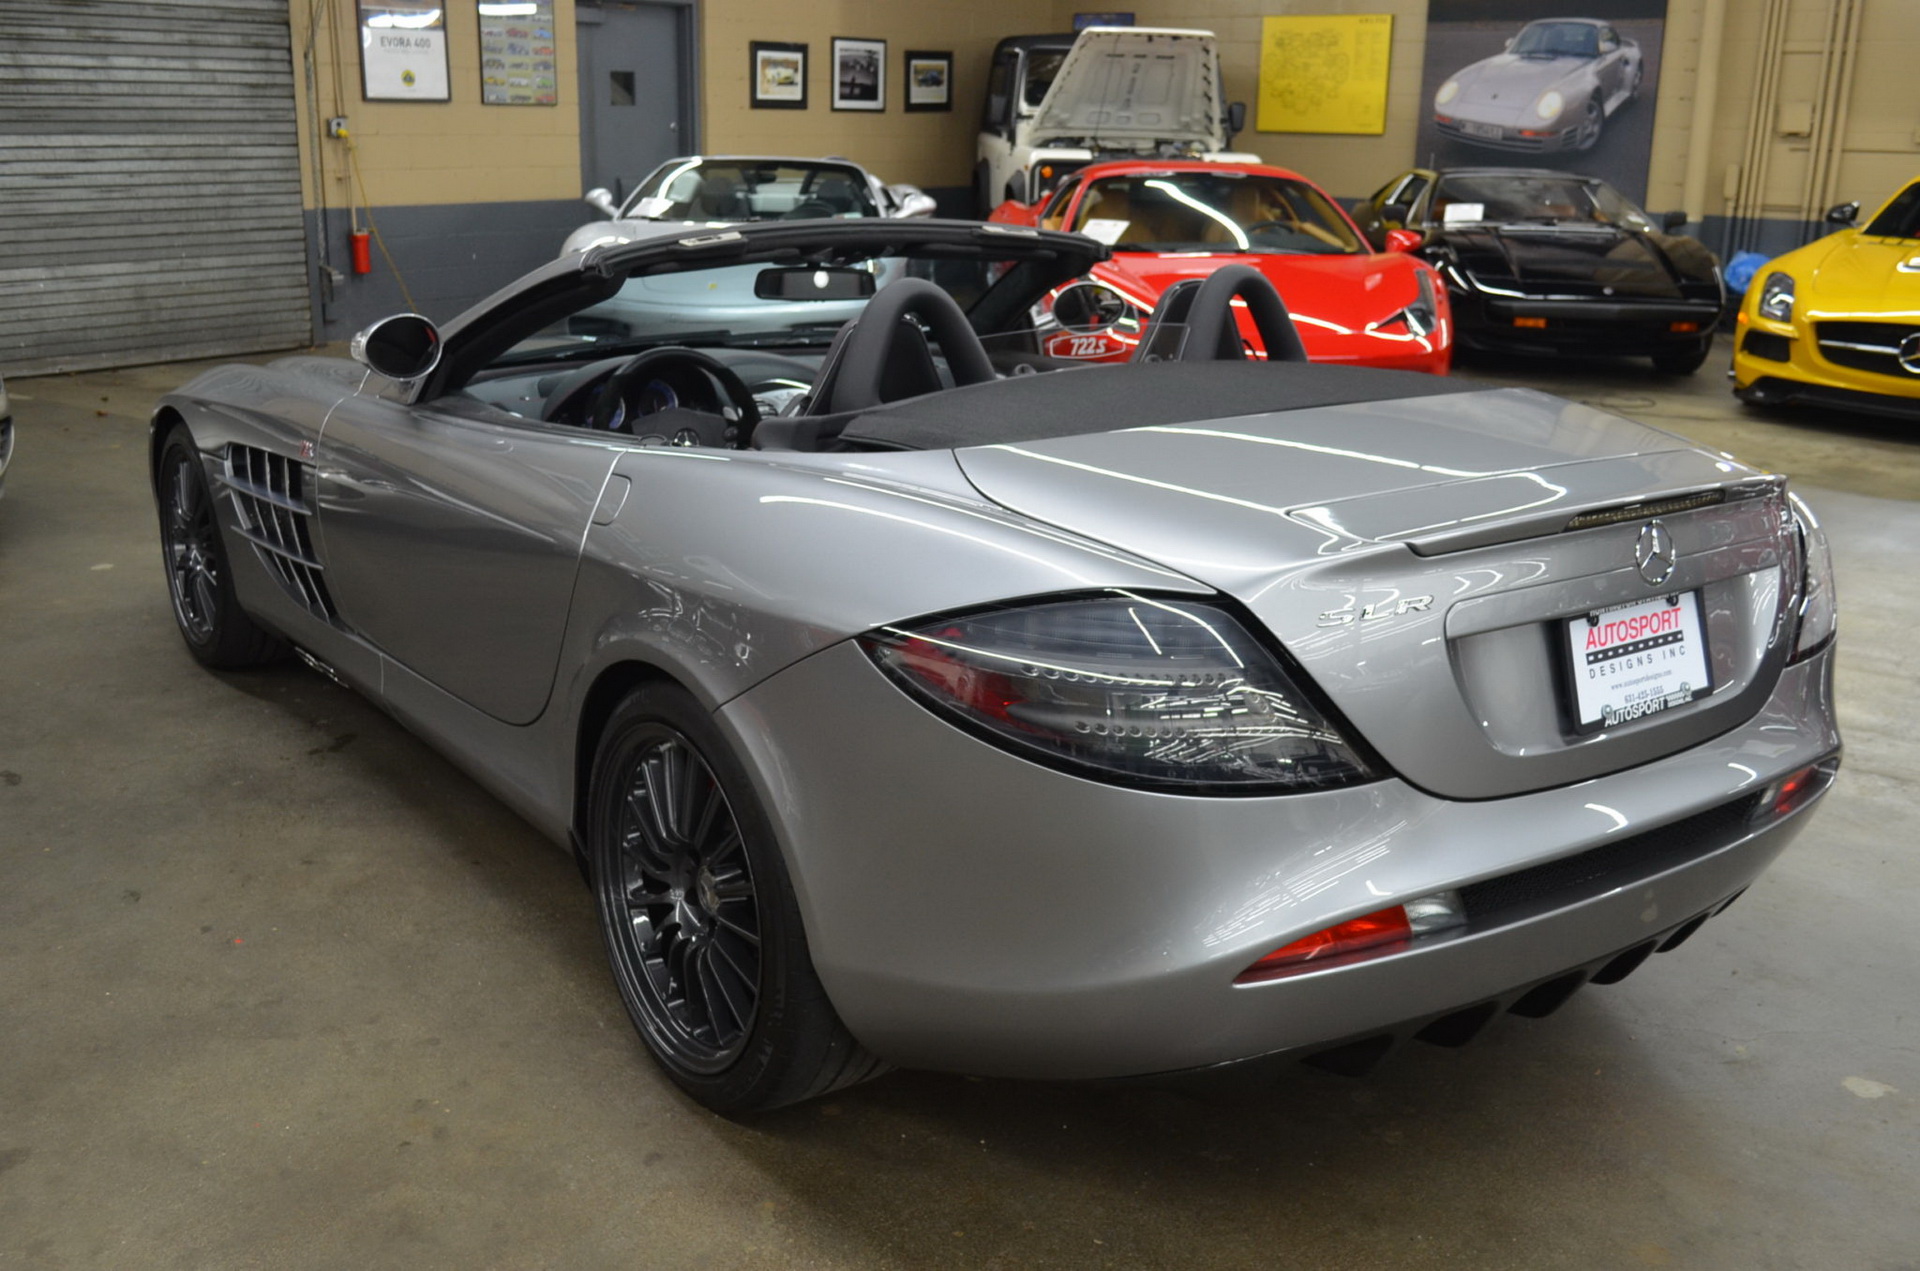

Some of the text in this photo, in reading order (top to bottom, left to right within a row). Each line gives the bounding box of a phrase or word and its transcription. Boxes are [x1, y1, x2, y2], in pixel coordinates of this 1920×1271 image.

[380, 35, 431, 49] EVORA 400
[1316, 594, 1435, 628] SLR
[1586, 607, 1682, 650] AUTOSPORT
[1589, 645, 1686, 680] DESIGNS INC
[1604, 697, 1665, 728] AUTOSPORT
